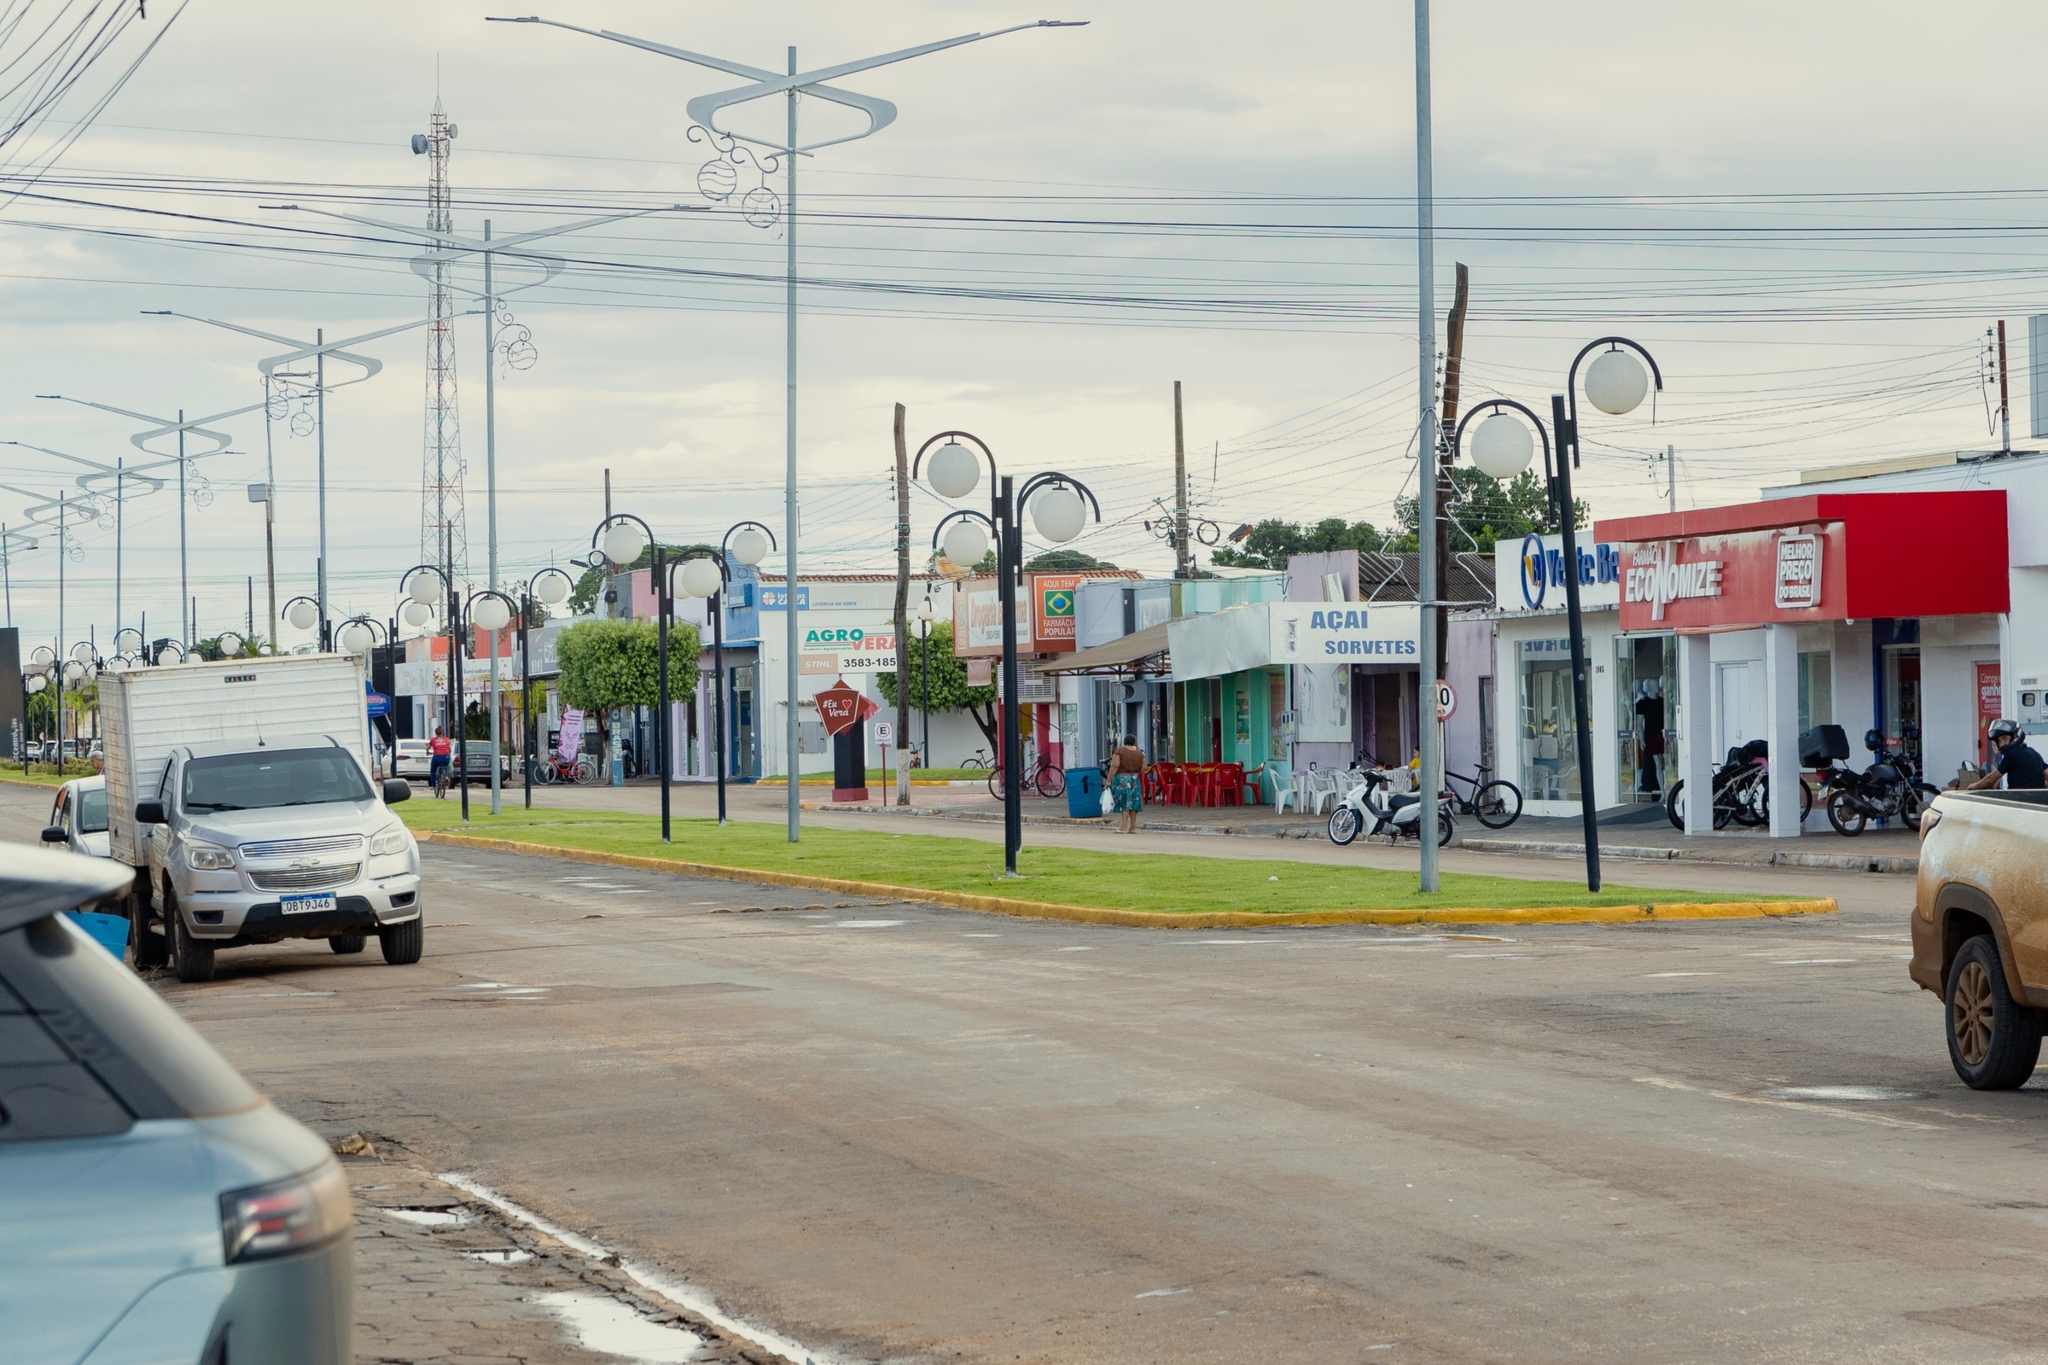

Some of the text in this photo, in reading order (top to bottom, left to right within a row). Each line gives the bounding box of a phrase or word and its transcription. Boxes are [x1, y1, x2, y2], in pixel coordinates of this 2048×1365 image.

[1781, 543, 1812, 560] MELHOR
[1546, 546, 1595, 587] Vete
[1780, 560, 1811, 584] PREÇO
[1043, 580, 1059, 588] AQUI
[1625, 541, 1721, 620] ECONOMIZE
[1779, 585, 1811, 599] DO BRASIL
[777, 598, 806, 606] CAA
[1043, 618, 1076, 627] FARMÁCIA
[1310, 610, 1368, 632] AÇAI
[806, 628, 864, 642] AGRO
[1044, 627, 1076, 636] POPULAR
[850, 637, 897, 651] VERA
[1325, 640, 1416, 655] SORVETES
[844, 658, 897, 668] 3583-185
[822, 699, 837, 709] #Eu
[828, 708, 850, 717] Vera
[879, 726, 887, 735] E
[286, 898, 330, 912] QBT9J46
